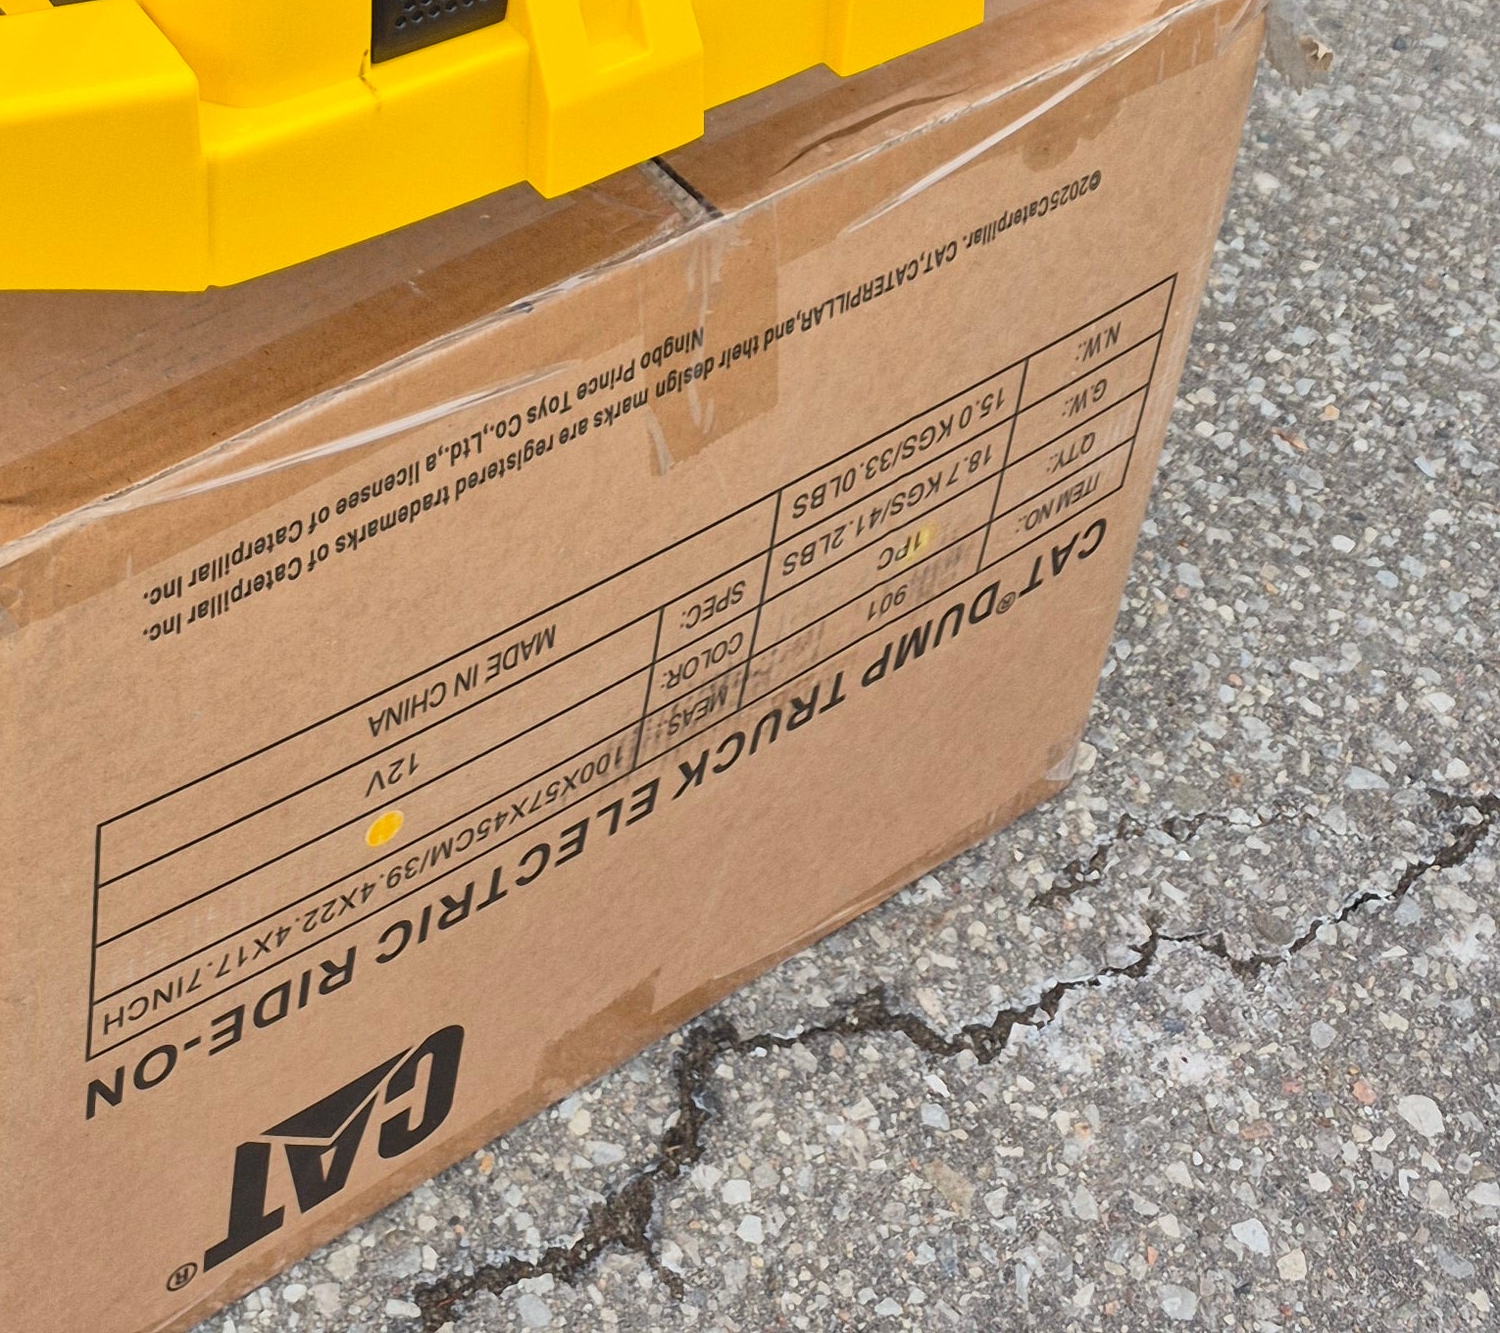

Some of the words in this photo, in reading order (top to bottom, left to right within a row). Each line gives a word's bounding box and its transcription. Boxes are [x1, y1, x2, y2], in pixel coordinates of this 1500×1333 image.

[639, 326, 704, 369] Ningbo
[717, 334, 759, 369] their
[575, 358, 635, 400] Prince
[654, 355, 714, 398] design
[525, 390, 572, 424] Toys
[592, 387, 648, 428] marks
[958, 386, 1004, 429] 15.0
[558, 416, 588, 444] are
[454, 433, 554, 501] registered
[791, 413, 954, 519] KGS/33.0LBS
[945, 443, 992, 487] 18.7
[334, 460, 419, 515] licensee
[1054, 471, 1100, 514] ITEM
[307, 505, 330, 535] of
[334, 485, 450, 553] trademarks
[781, 470, 942, 576] KGS/41.2LBS
[187, 519, 303, 587] Caterpillar
[306, 542, 329, 572] of
[876, 531, 920, 570] 1PC
[143, 575, 182, 605] Inc.
[186, 556, 302, 624] Caterpillar
[679, 579, 746, 629] SPEC:
[866, 583, 908, 621] 901
[142, 612, 181, 641] Inc.
[483, 623, 556, 683] MADE
[660, 631, 744, 689] COLOR:
[453, 662, 479, 697] IN
[367, 680, 447, 737] CHINA
[671, 670, 846, 800] TRUCK
[364, 752, 419, 798] 12V
[374, 776, 661, 964] ELECTRIC
[85, 944, 357, 1120] RIDE-ON
